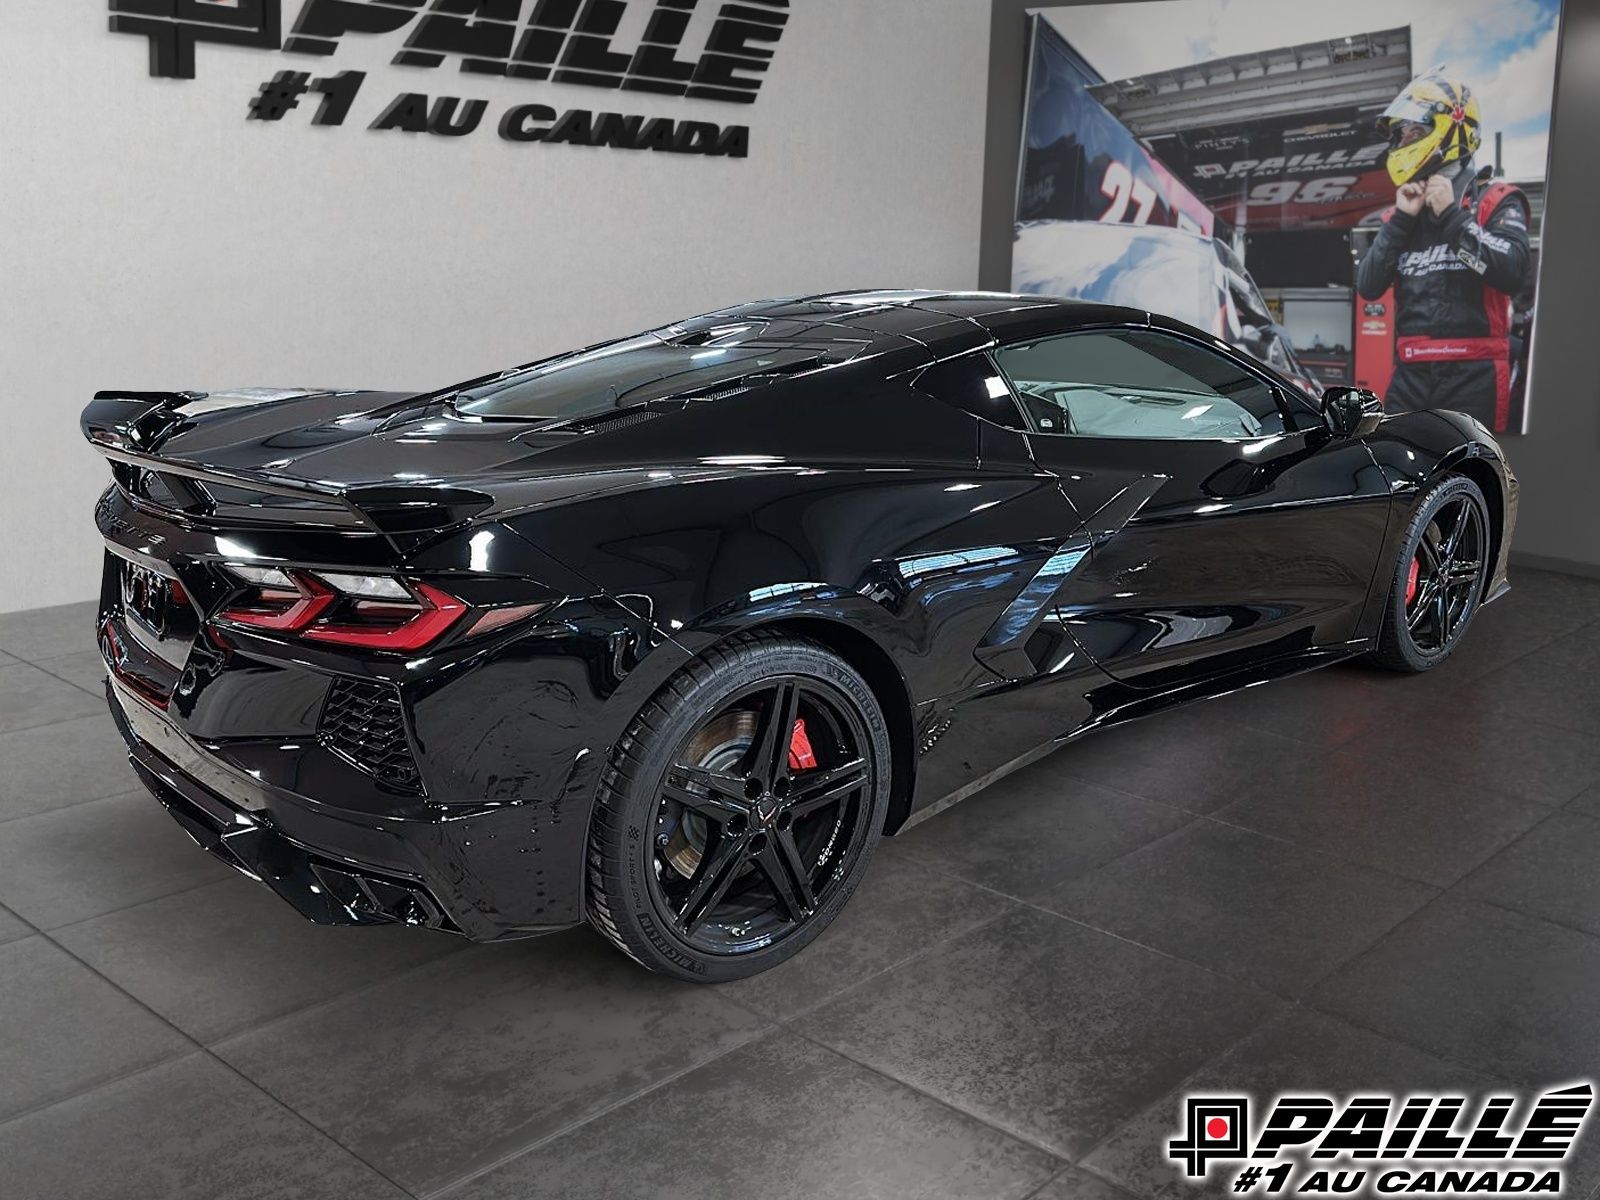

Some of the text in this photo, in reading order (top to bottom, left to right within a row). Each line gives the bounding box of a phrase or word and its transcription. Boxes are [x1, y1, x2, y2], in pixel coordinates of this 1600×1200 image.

[246, 70, 750, 158] #1 AU CANADA
[1247, 176, 1357, 206] 96
